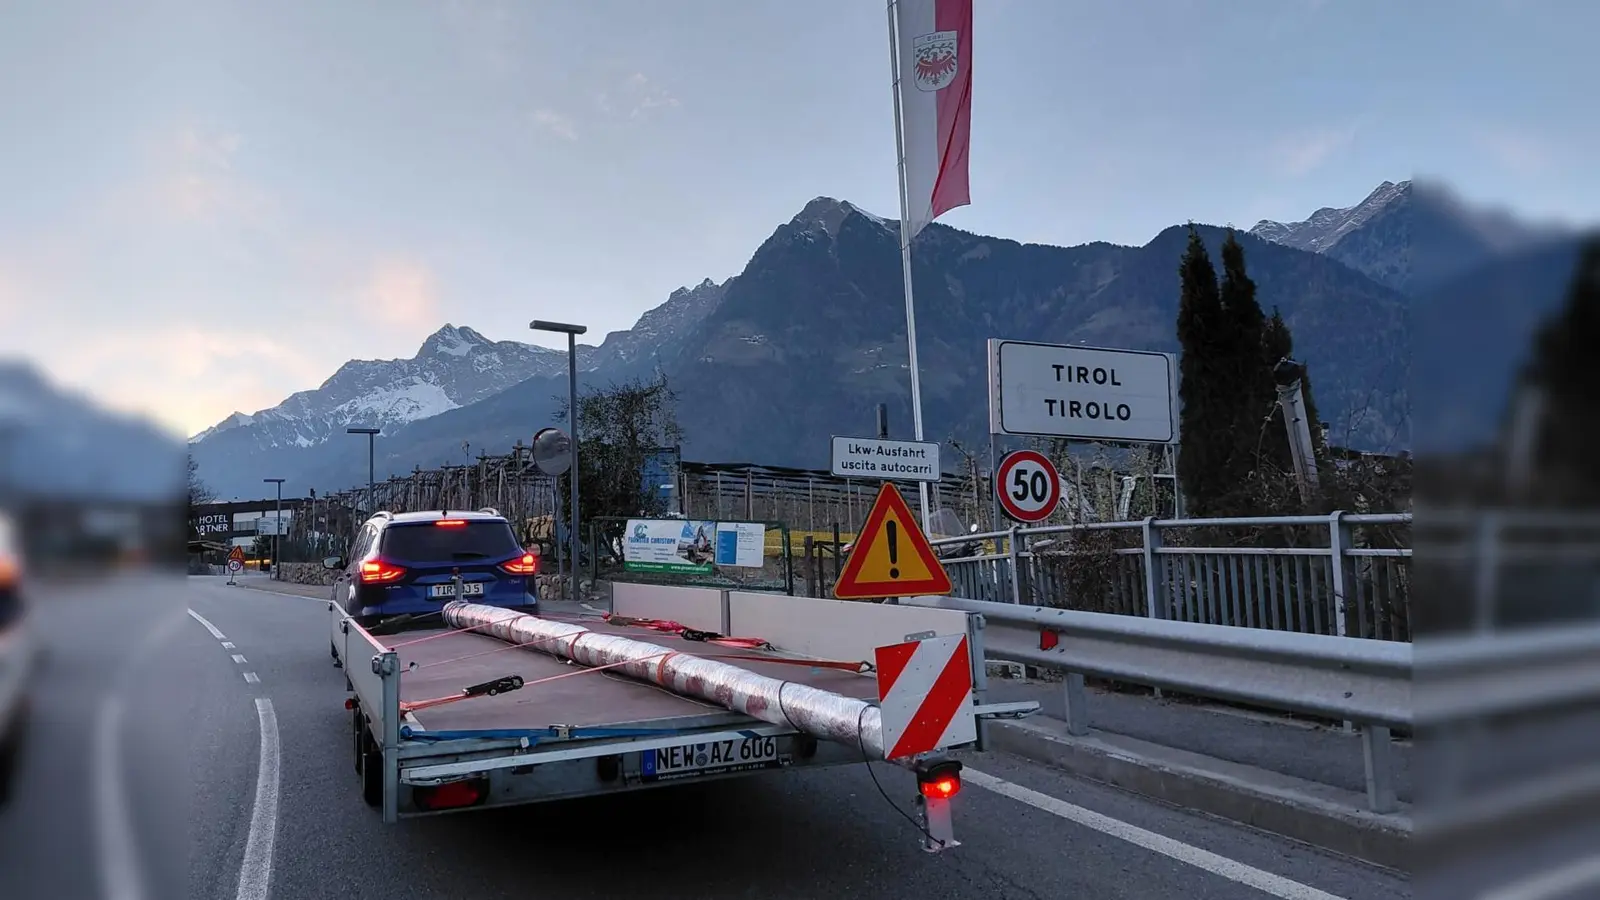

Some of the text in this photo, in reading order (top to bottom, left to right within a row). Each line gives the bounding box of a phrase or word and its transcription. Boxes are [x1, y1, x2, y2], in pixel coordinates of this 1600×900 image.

[1052, 364, 1121, 386] TIROL
[1044, 399, 1131, 421] TIROLO
[848, 443, 925, 458] Lkw-Ausfahrt
[841, 460, 932, 474] uscita autocarri
[1012, 469, 1047, 503] 50
[199, 514, 228, 524] HOTEL
[435, 586, 452, 595] TIR
[474, 584, 480, 593] 5
[656, 744, 694, 770] NEW
[710, 740, 734, 764] AZ
[740, 736, 775, 760] 606
